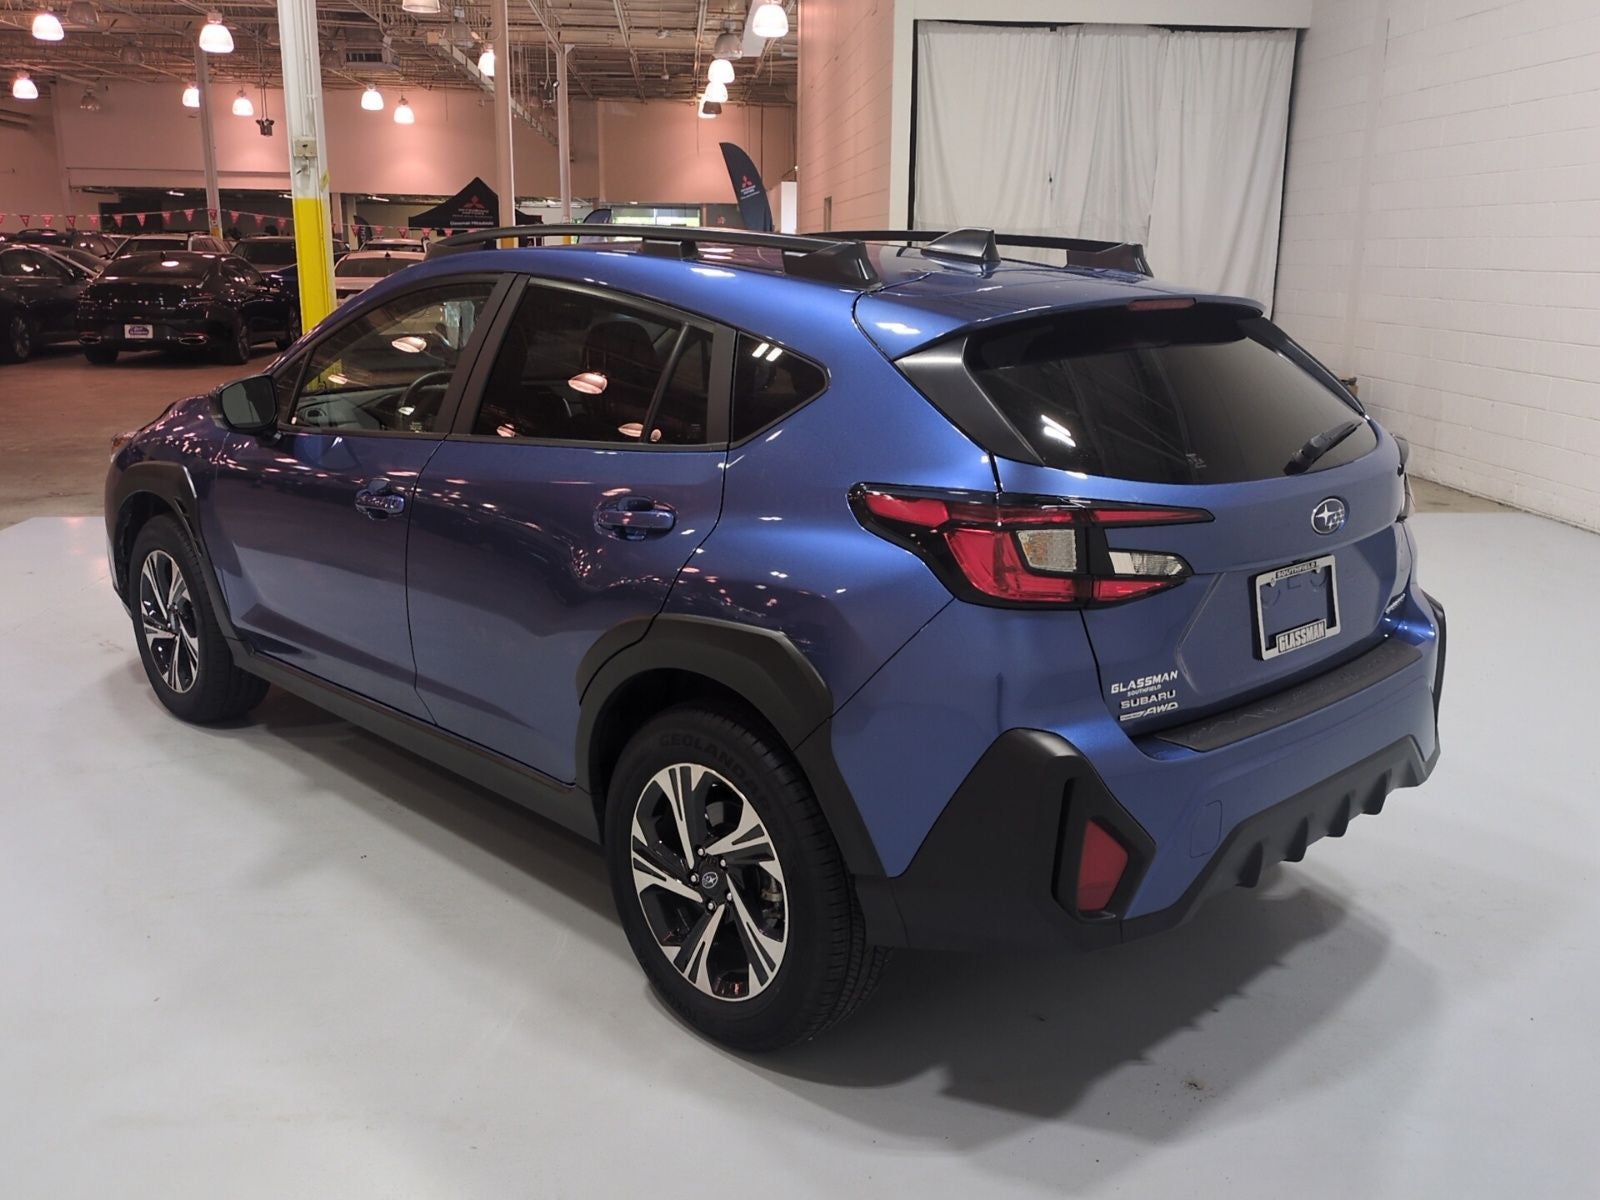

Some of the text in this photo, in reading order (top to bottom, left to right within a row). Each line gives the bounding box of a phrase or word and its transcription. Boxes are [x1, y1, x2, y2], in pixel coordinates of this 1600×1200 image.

[1278, 620, 1325, 653] GLASSMAN
[1111, 670, 1178, 694] GLASSMAN
[1120, 689, 1176, 709] SUBARU
